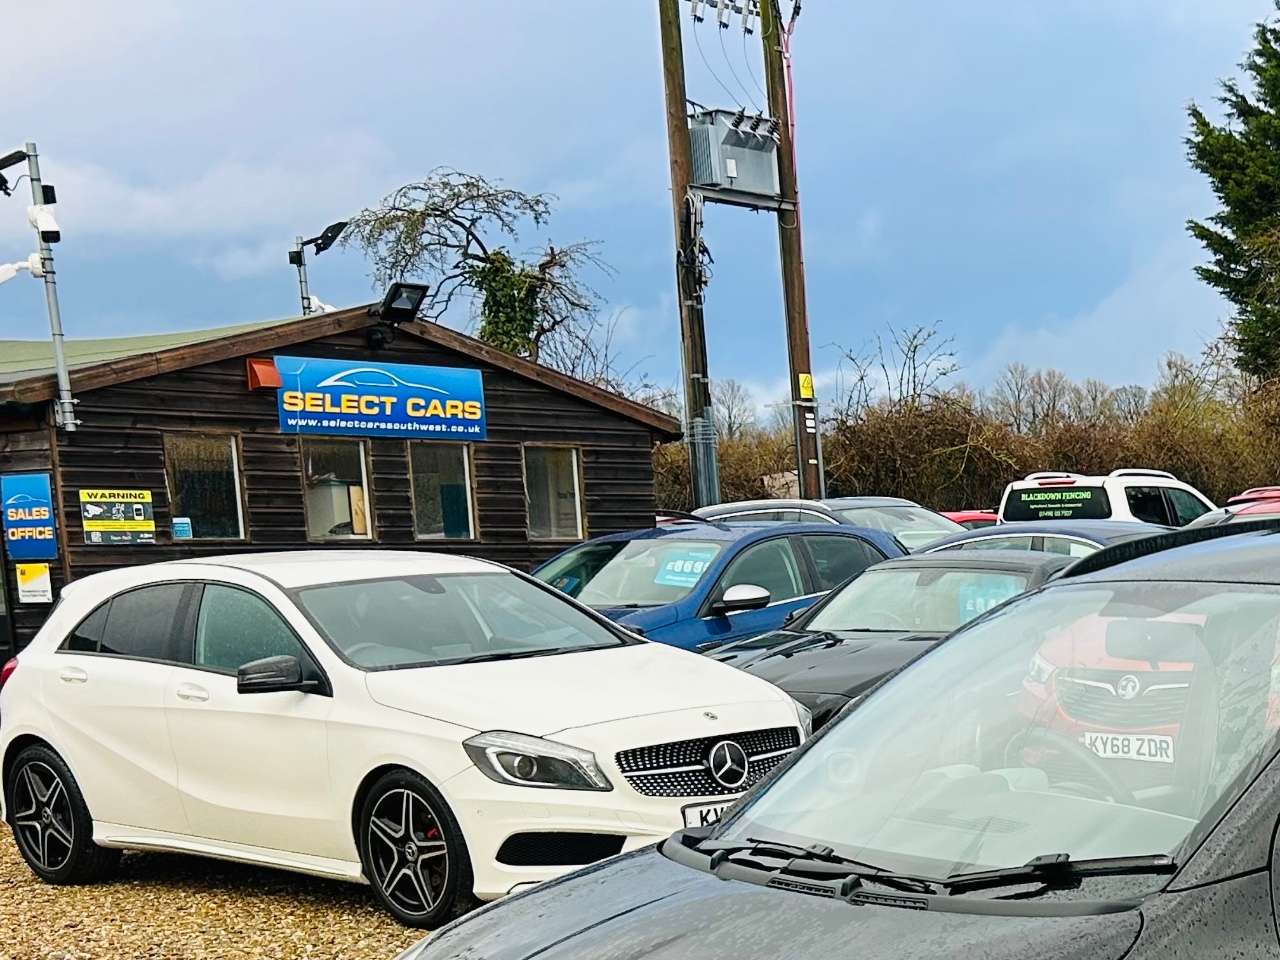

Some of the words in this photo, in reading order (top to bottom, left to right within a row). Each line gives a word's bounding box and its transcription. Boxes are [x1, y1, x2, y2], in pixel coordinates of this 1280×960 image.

[282, 391, 398, 415] SELECT
[406, 397, 482, 419] CARS
[287, 418, 481, 433] www.selectcarssouthwest.co.uk
[87, 492, 146, 500] WARNING
[1021, 492, 1061, 501] BLACKDOWN
[1062, 491, 1092, 500] FENCING
[7, 507, 49, 521] SALES
[8, 527, 53, 541] OFFICE
[1088, 735, 1131, 754] KY68
[1135, 738, 1170, 758] ZDR
